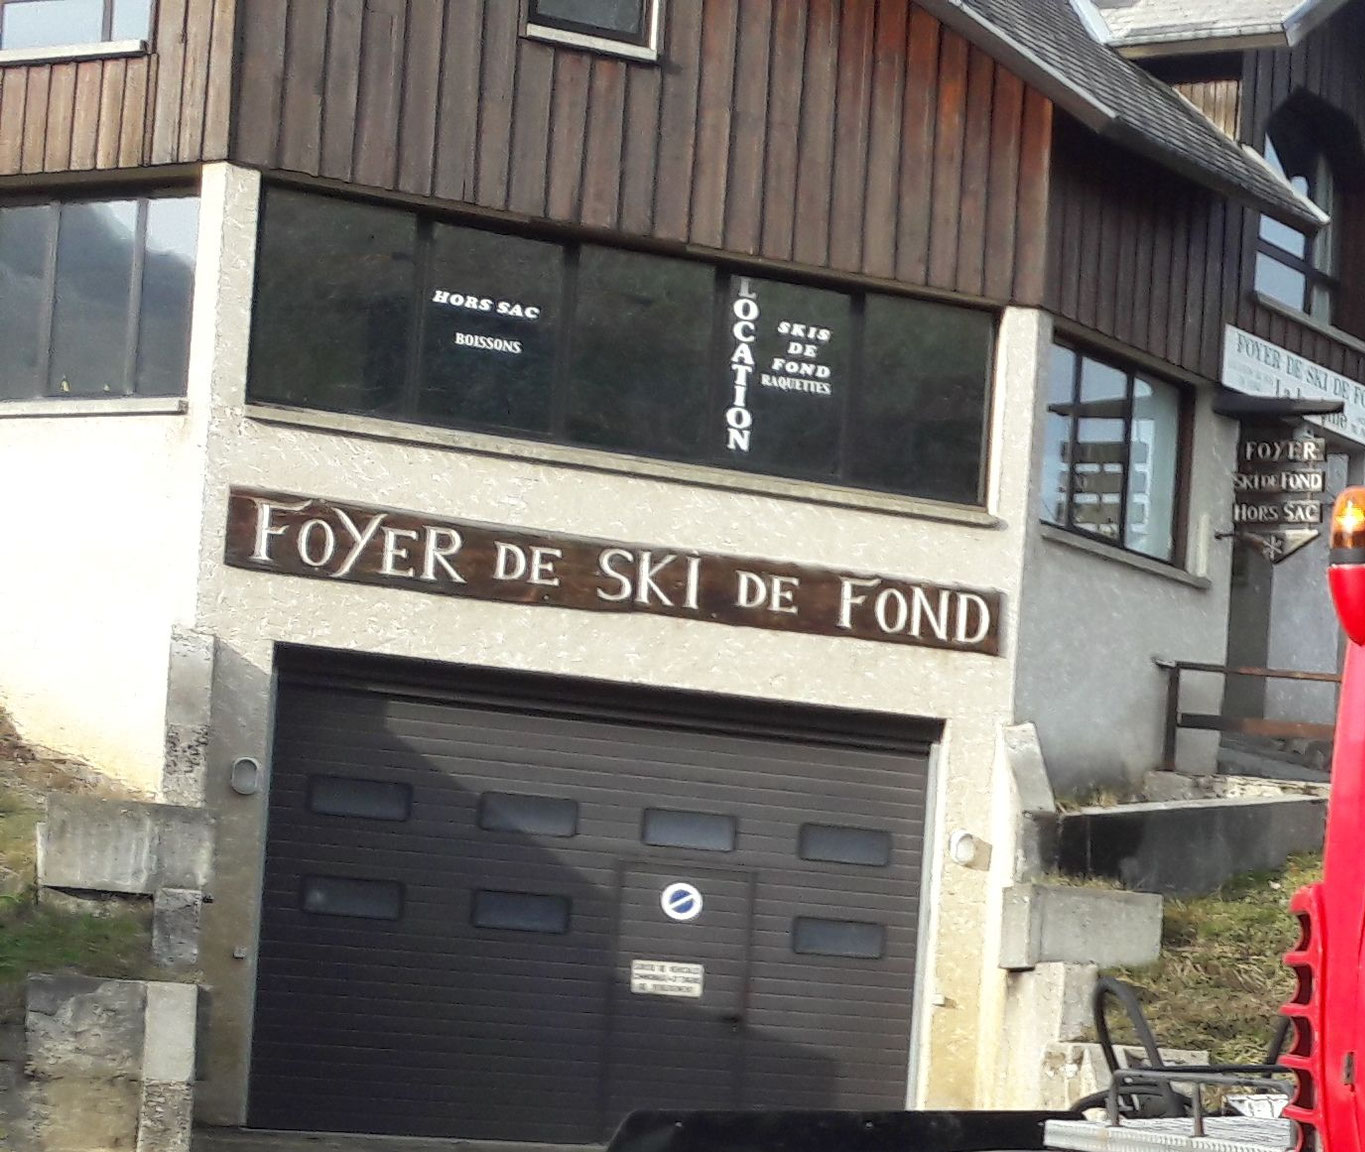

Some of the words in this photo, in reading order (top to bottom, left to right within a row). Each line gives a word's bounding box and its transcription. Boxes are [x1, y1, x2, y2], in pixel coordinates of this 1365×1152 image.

[432, 290, 491, 313] HORS
[496, 301, 541, 320] SAC
[777, 321, 832, 341] SKIS
[455, 332, 523, 355] BOISSONS
[788, 342, 818, 359] DE
[725, 275, 760, 453] LOCATION
[771, 357, 831, 379] FOND
[1236, 331, 1281, 369] FOYER
[1286, 353, 1302, 378] DE
[1306, 365, 1329, 391] SKI
[1333, 377, 1349, 398] DE
[760, 373, 832, 396] RAQUETTES
[1245, 441, 1319, 462] FOYER
[1234, 472, 1260, 489] SKI
[1261, 473, 1277, 488] DE
[1281, 471, 1322, 489] FOND
[1234, 503, 1279, 522] HORS
[1283, 501, 1318, 522] SAC
[248, 498, 467, 584] FOYER
[491, 540, 563, 587] DE
[596, 547, 700, 610] SKI
[735, 569, 799, 615] DE
[835, 575, 991, 644] FOND
